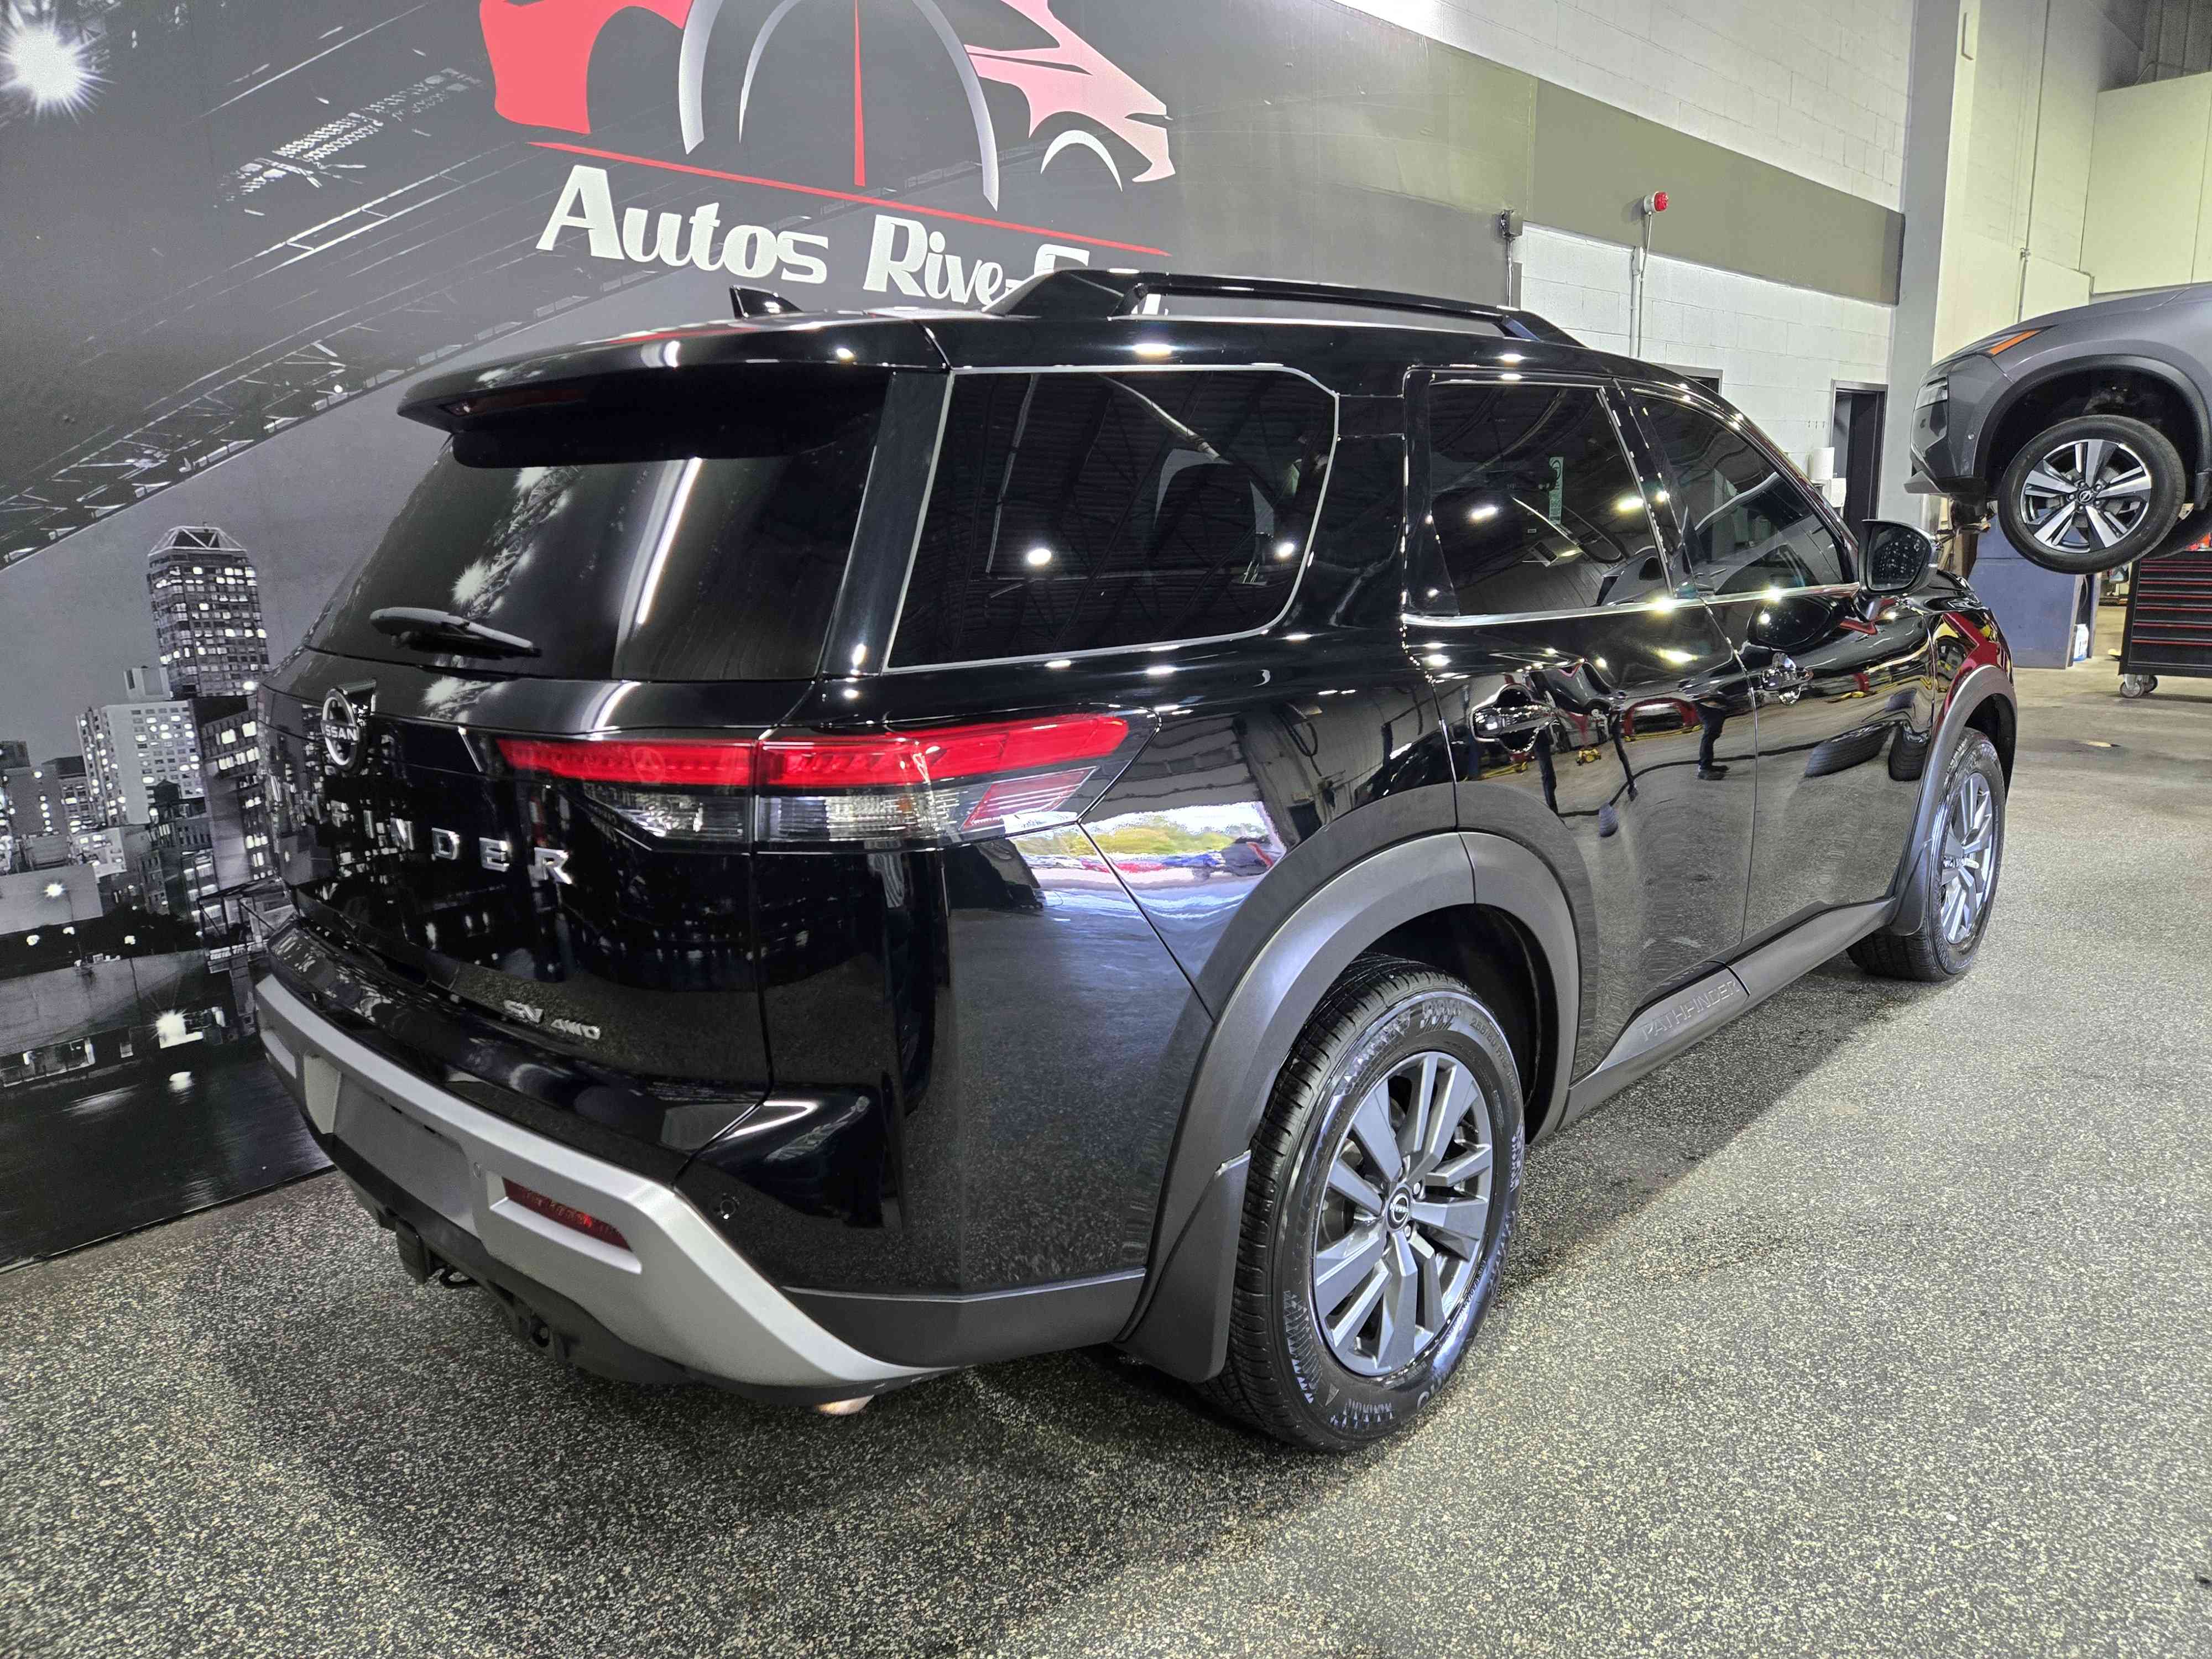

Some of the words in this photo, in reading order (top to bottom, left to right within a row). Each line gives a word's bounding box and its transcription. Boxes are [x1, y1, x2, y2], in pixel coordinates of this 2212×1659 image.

[535, 164, 828, 284] Autos
[863, 214, 1170, 315] Rive-
[325, 724, 358, 741] SSAN
[1639, 980, 1740, 1041] PATHFINDER
